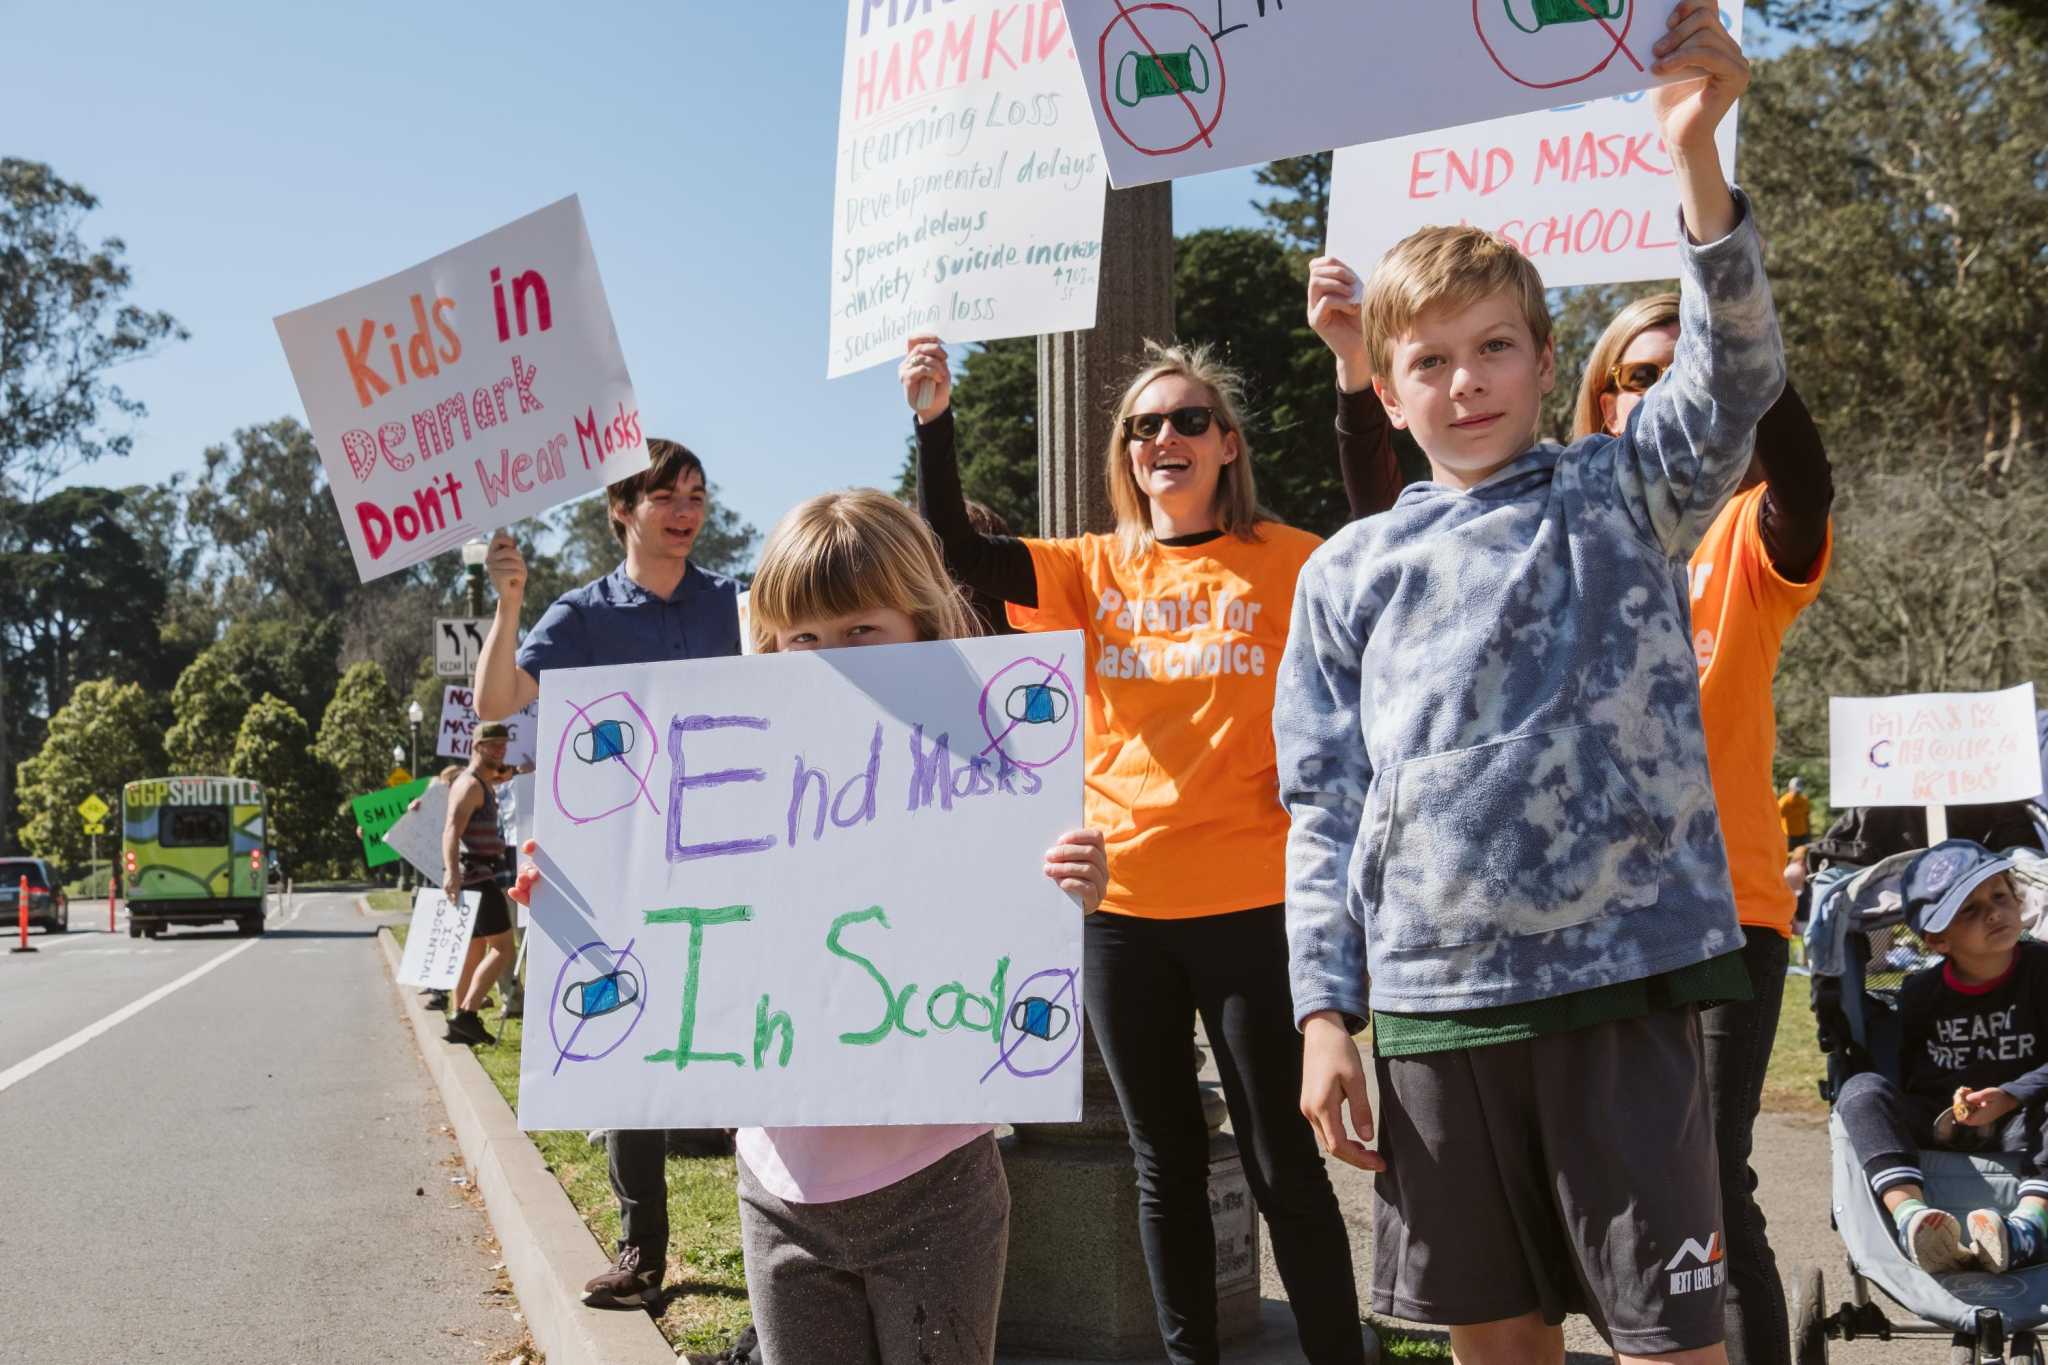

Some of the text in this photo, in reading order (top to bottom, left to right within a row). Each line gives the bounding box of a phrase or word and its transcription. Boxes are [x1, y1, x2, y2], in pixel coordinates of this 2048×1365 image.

[855, 14, 976, 120] HARM
[982, 0, 1075, 80] KID
[985, 91, 1060, 127] Loss
[1016, 147, 1097, 192] delays
[1408, 131, 1674, 199] END MASK
[912, 208, 989, 247] delays
[1498, 208, 1678, 257] SCHOOL
[949, 291, 997, 321] loss
[335, 265, 553, 409] Kids in
[341, 354, 545, 483] Denmark
[355, 402, 643, 560] Don't Wear Masks
[1096, 588, 1211, 633] Parents
[1096, 632, 1265, 680] ask Choice
[169, 780, 260, 806] SHUTTLE
[664, 713, 1044, 864] End Masks
[642, 904, 794, 1071] In
[1669, 1270, 1693, 1295] NEXT
[1694, 1266, 1712, 1291] LEVEL
